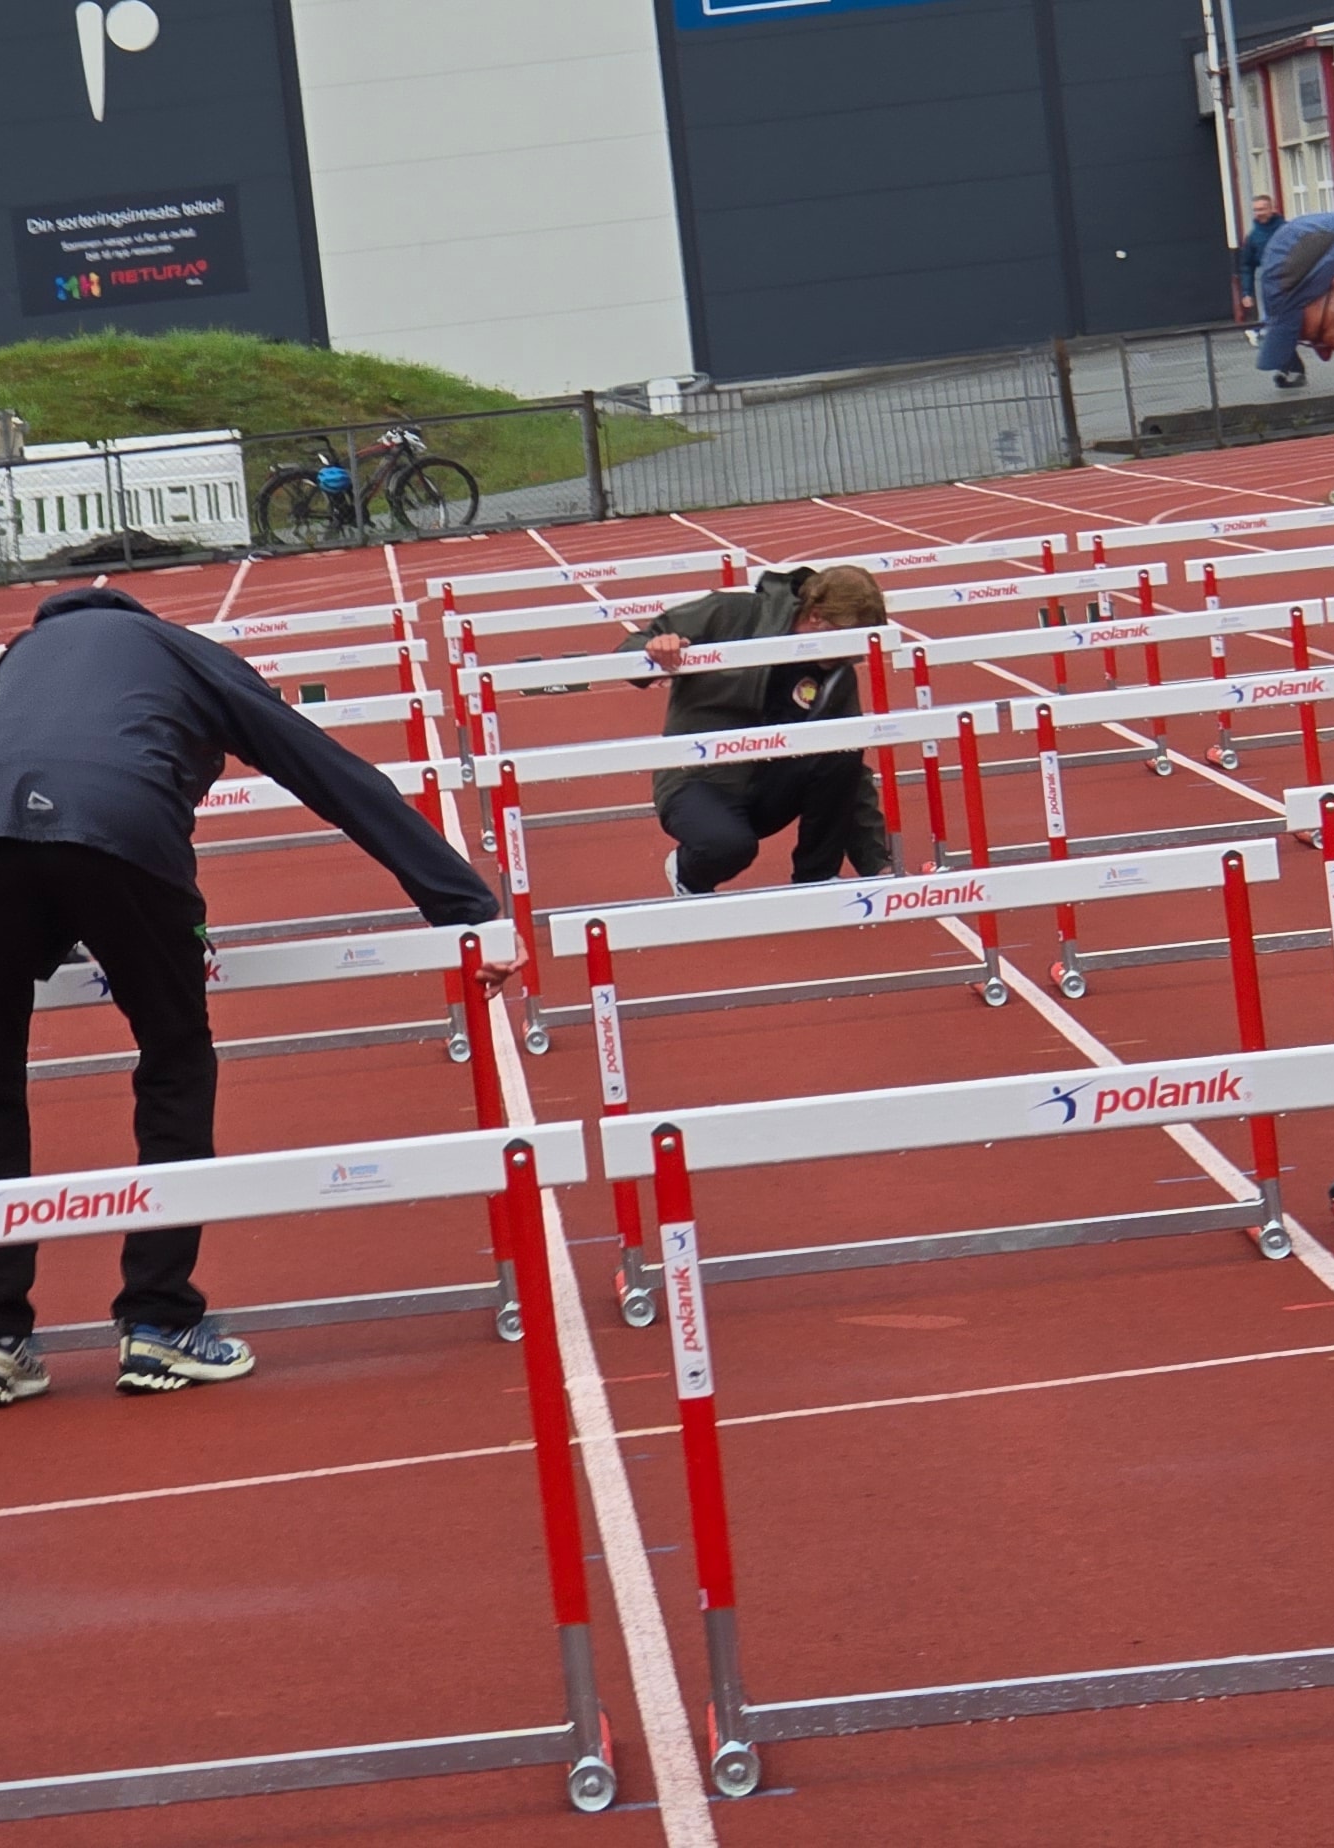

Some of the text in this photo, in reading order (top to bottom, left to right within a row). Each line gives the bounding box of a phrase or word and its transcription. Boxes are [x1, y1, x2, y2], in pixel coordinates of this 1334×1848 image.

[110, 263, 201, 285] RETURA
[968, 583, 1019, 602] polanik
[1090, 623, 1149, 645] polanik
[1252, 676, 1324, 703] polanik
[714, 732, 787, 759] polanik
[884, 878, 984, 918] polanik
[598, 1012, 622, 1075] polanik
[1093, 1067, 1243, 1126] polanik
[2, 1179, 152, 1237] polanik
[670, 1264, 704, 1354] polanik
